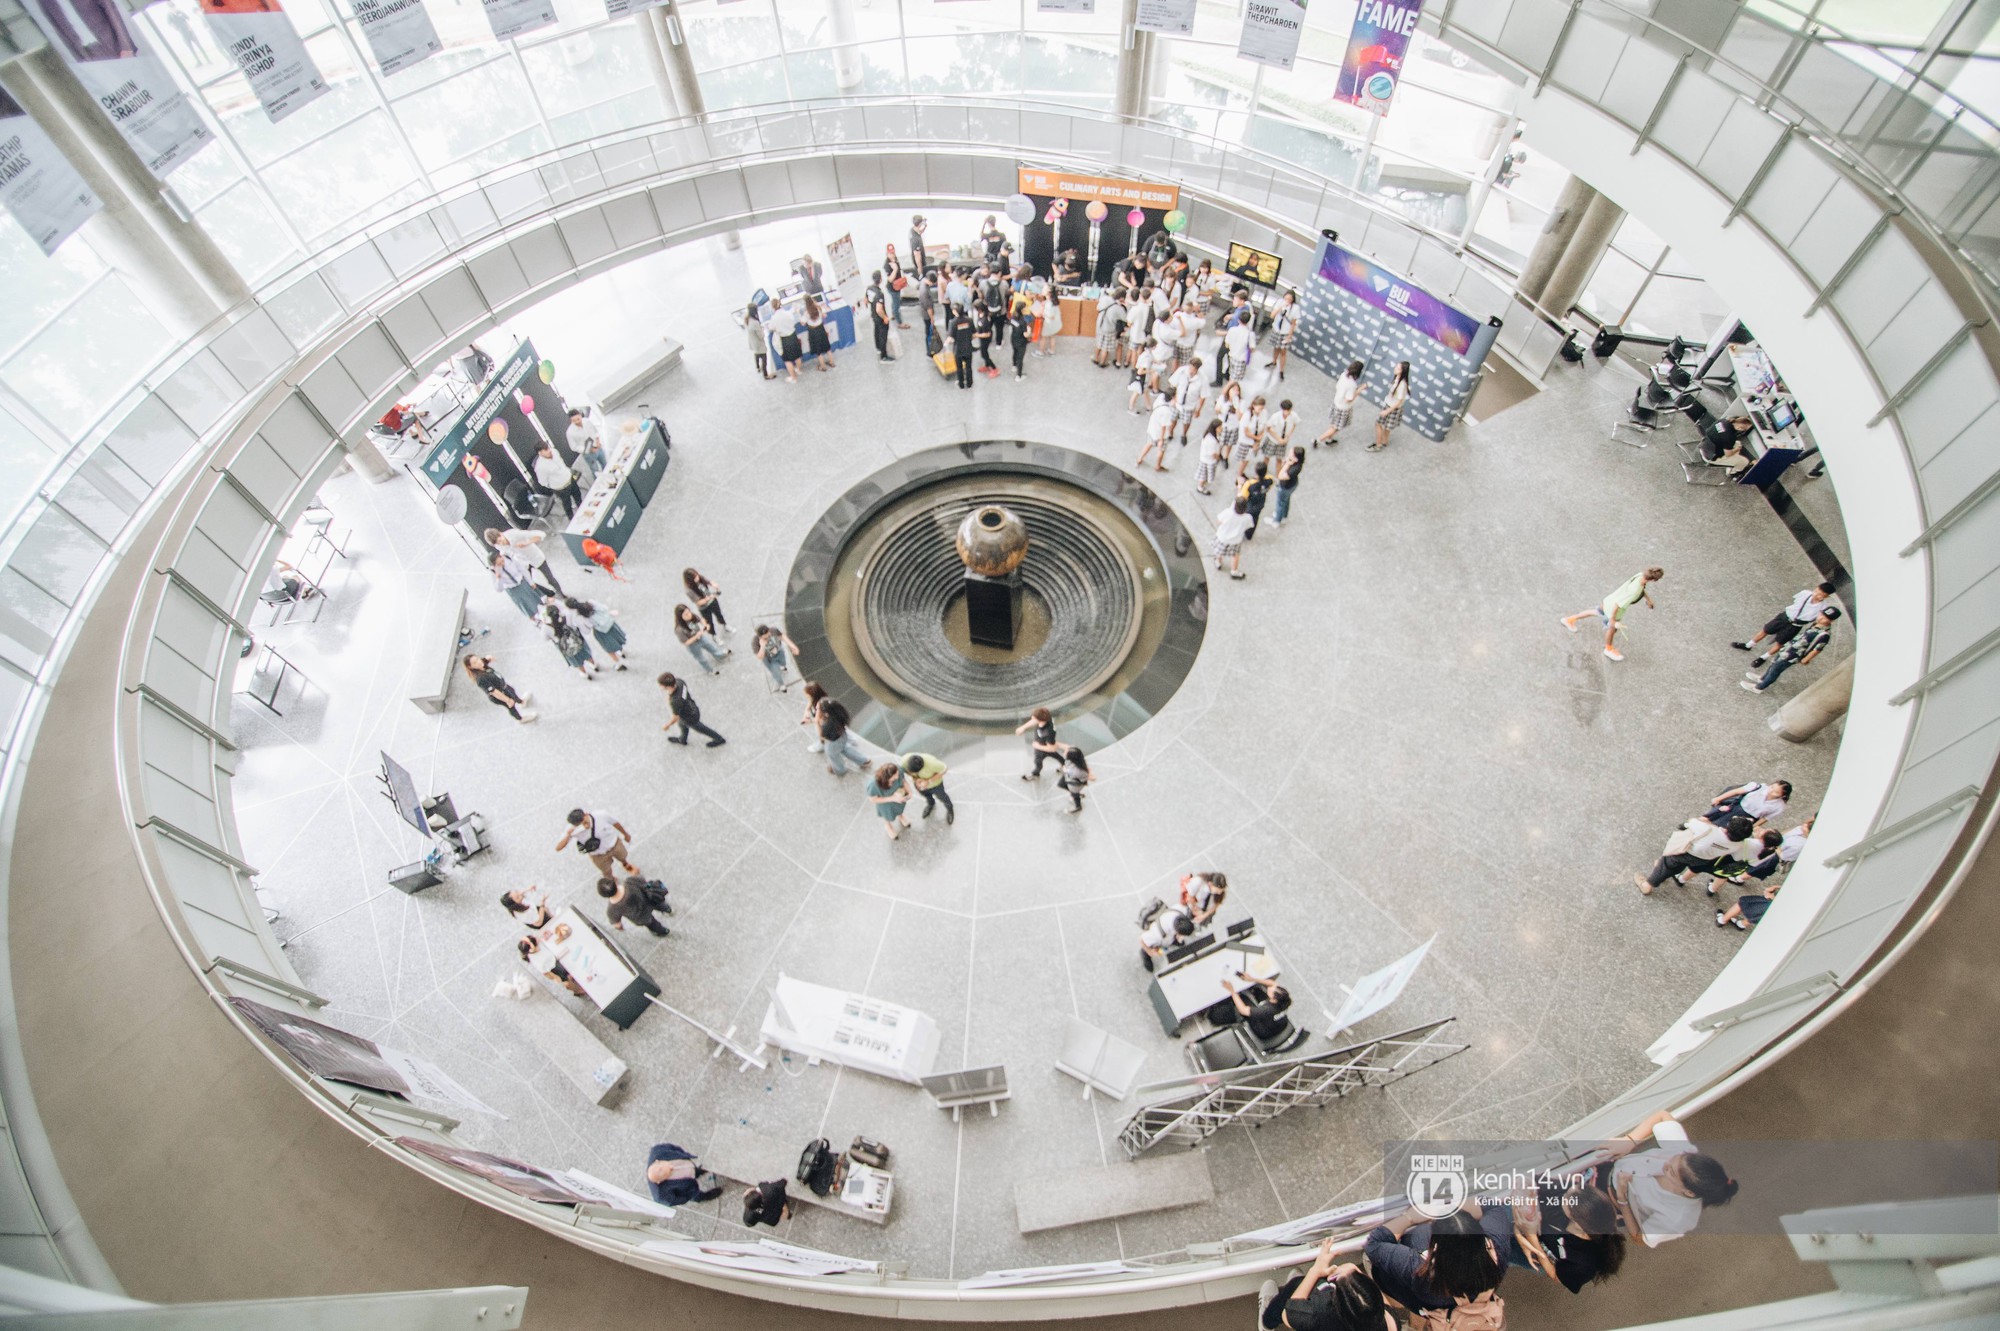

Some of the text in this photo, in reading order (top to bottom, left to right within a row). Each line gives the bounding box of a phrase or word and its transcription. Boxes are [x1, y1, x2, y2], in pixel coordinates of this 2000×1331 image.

[352, 0, 380, 15] DANAI
[357, 0, 420, 26] DEEROJANAWON
[1248, 2, 1279, 16] SIRAWIT
[1357, 0, 1419, 38] FAME
[1247, 11, 1299, 30] THEPCHAROEN
[230, 35, 257, 56] CINDY
[238, 44, 274, 68] SIRINYA
[244, 56, 275, 79] BISHOP
[101, 79, 139, 109] CHAWIN
[111, 89, 154, 121] SRABOUR
[1059, 181, 1099, 194] CULINARY
[1100, 186, 1121, 197] ARTS
[1122, 189, 1140, 199] AND
[1141, 191, 1172, 203] DESIGN
[1388, 284, 1410, 305] BUI
[462, 355, 533, 447] AND HOSPITALITY MANAGEMENT
[465, 357, 523, 430] INTERNATIONAL TOURISM
